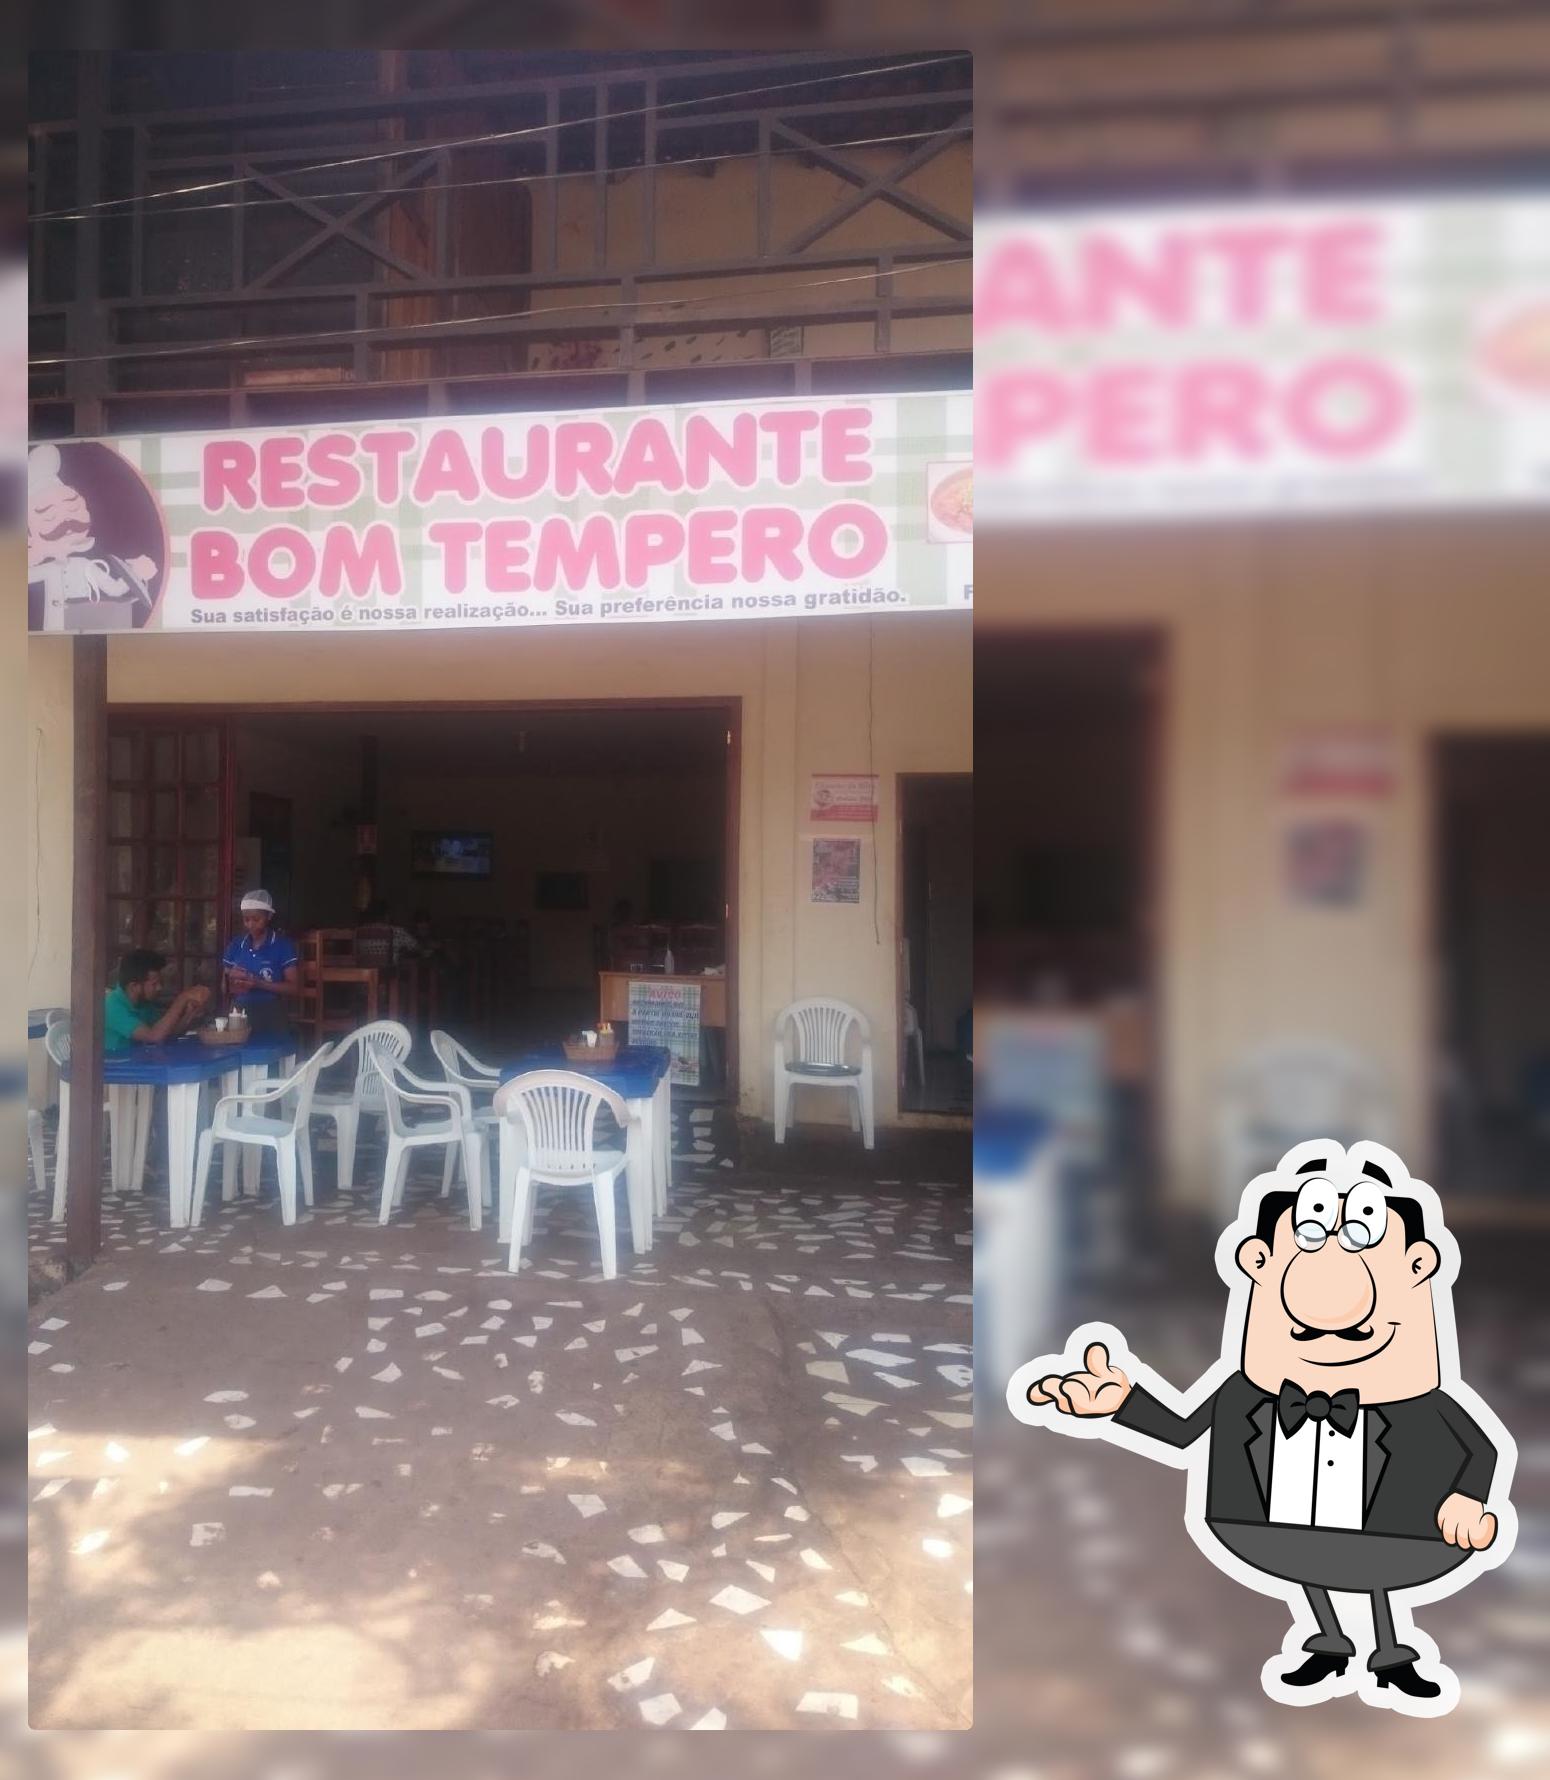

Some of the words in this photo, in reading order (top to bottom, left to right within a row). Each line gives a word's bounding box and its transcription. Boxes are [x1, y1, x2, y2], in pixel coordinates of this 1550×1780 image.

[203, 408, 873, 511] RESTAURANTE
[191, 522, 401, 600] BOM
[428, 503, 888, 594] TEMPERO
[191, 608, 227, 624] Sua
[233, 606, 334, 625] satisfação
[341, 605, 353, 620] é
[359, 606, 417, 621] nossa
[424, 602, 548, 621] realização...
[555, 600, 593, 617] Sua
[600, 594, 723, 617] preferência
[731, 594, 797, 609] nossa
[804, 587, 906, 609] gratidão.
